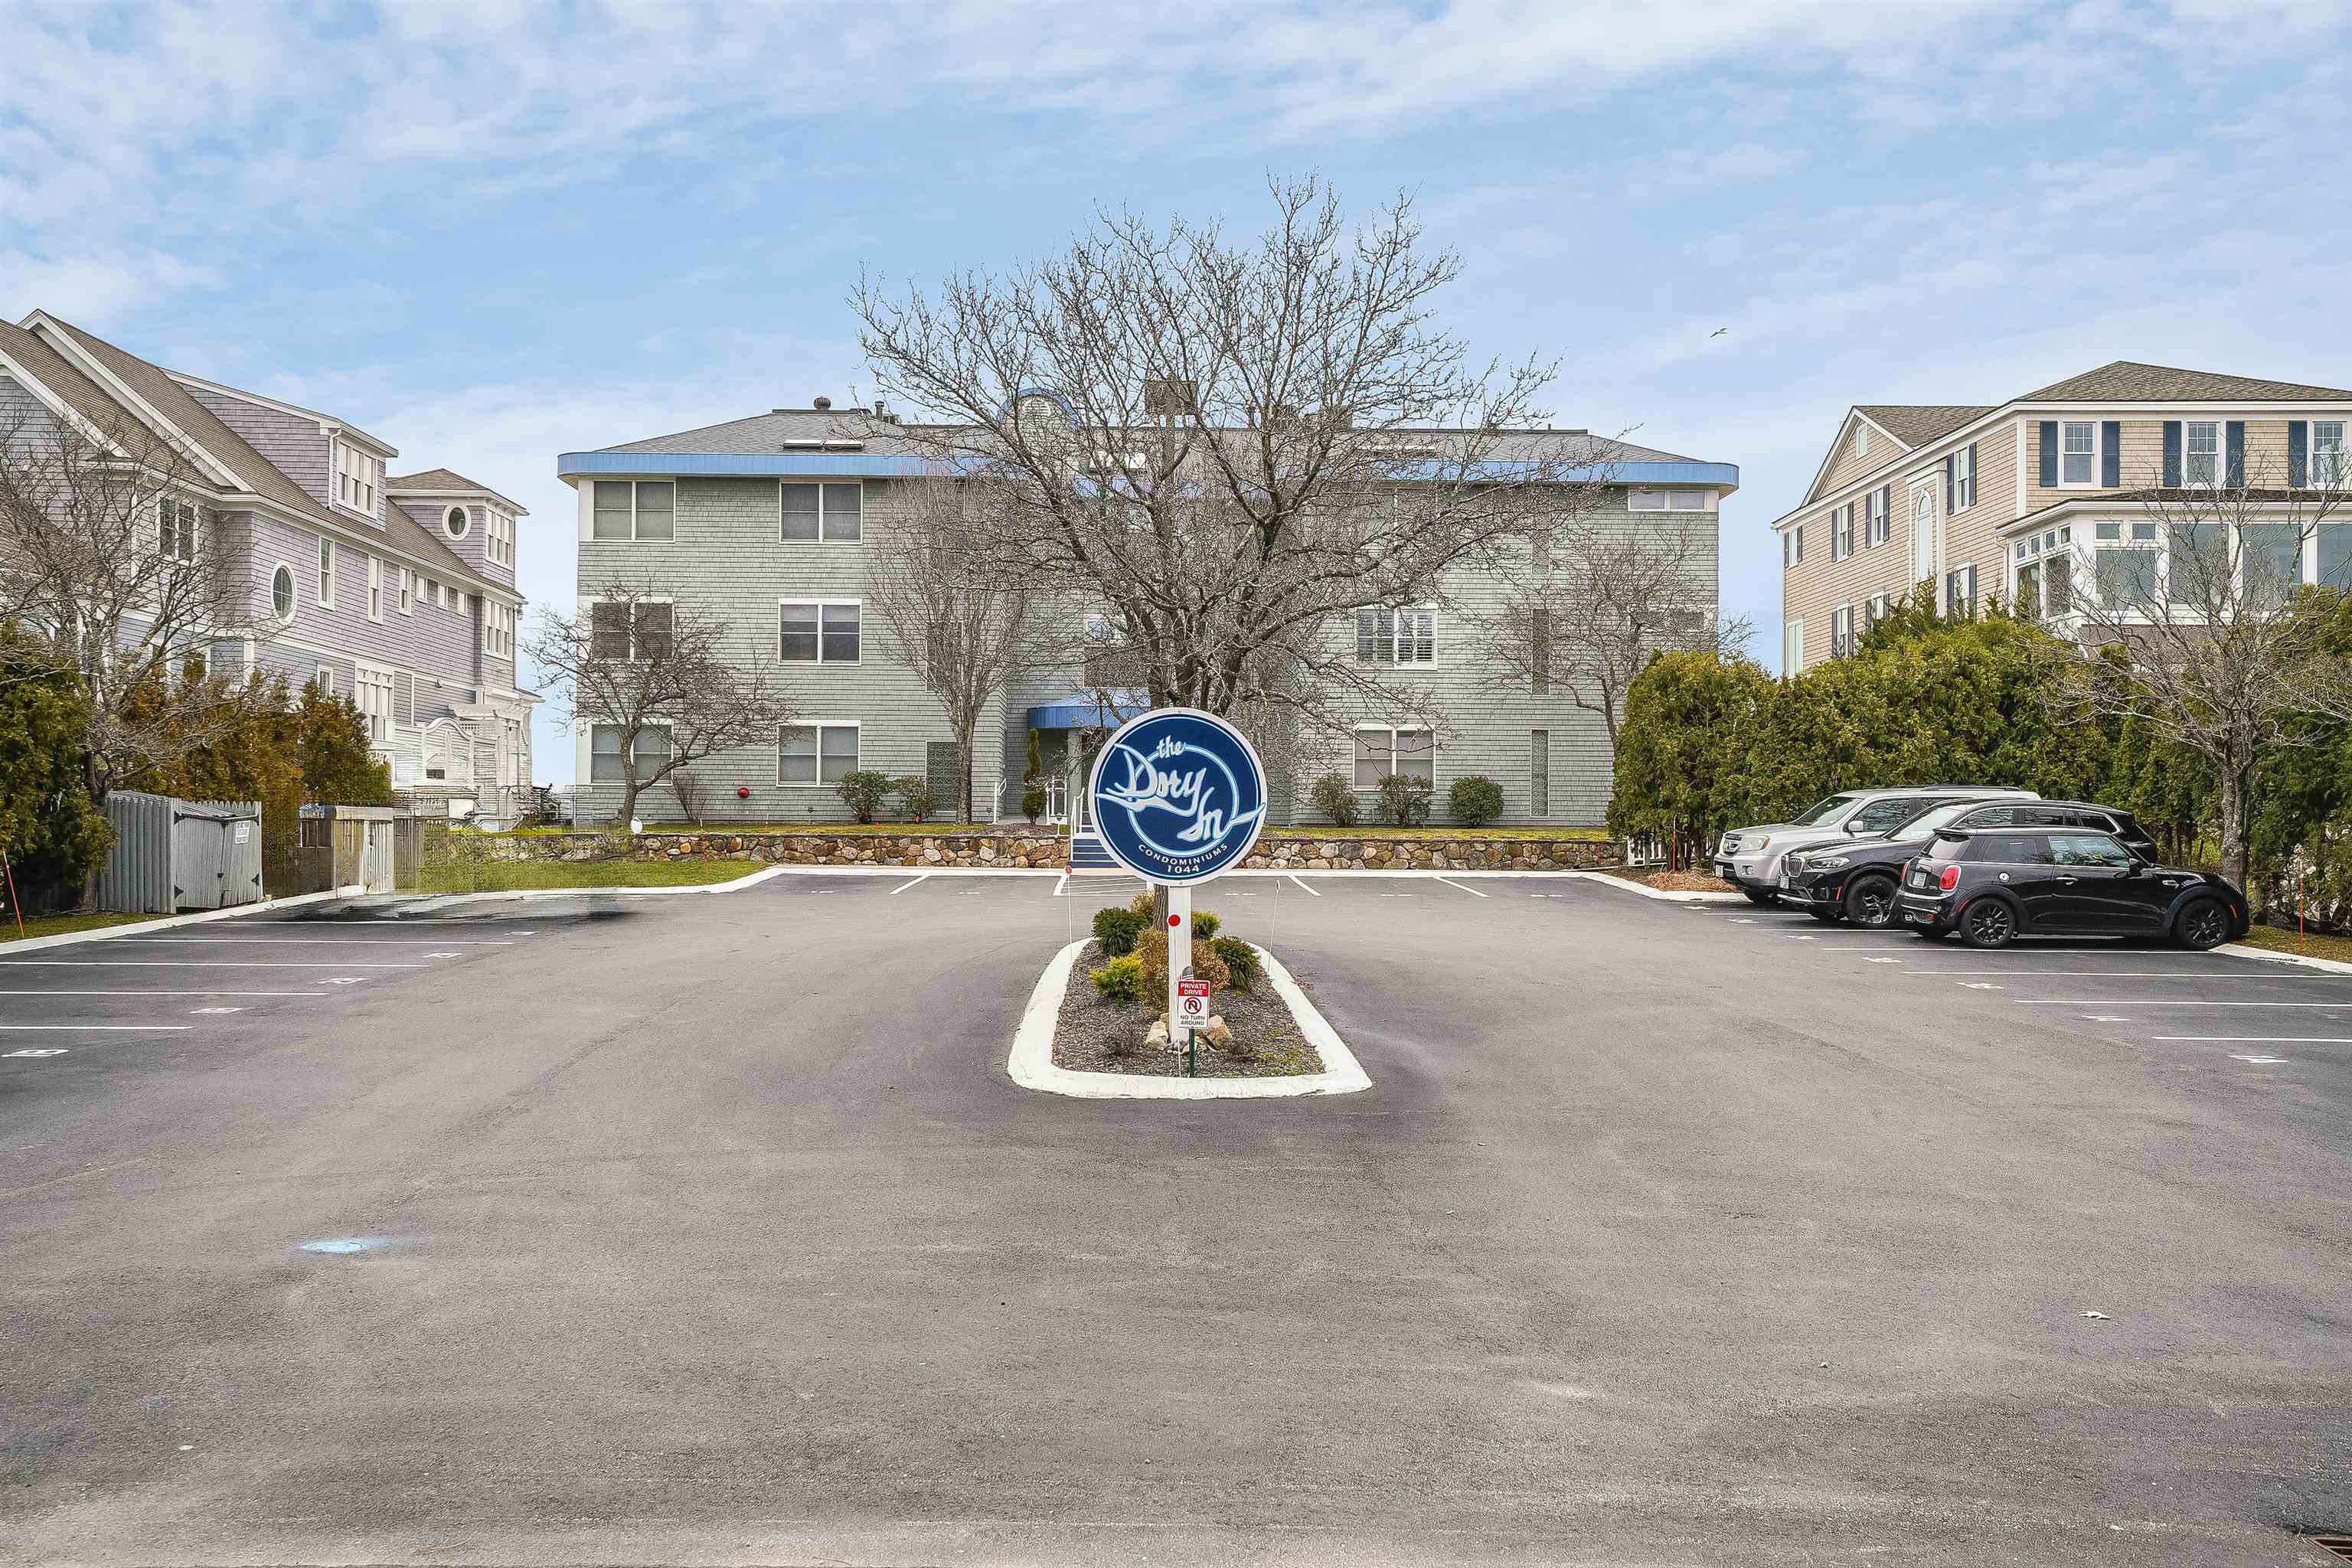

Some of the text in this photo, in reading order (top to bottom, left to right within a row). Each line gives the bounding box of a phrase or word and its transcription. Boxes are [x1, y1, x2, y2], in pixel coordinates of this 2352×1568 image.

[1156, 735, 1184, 758] the
[1096, 743, 1207, 817] Dory
[1138, 844, 1228, 865] CONDOMINIUMS
[1167, 864, 1200, 874] 1044
